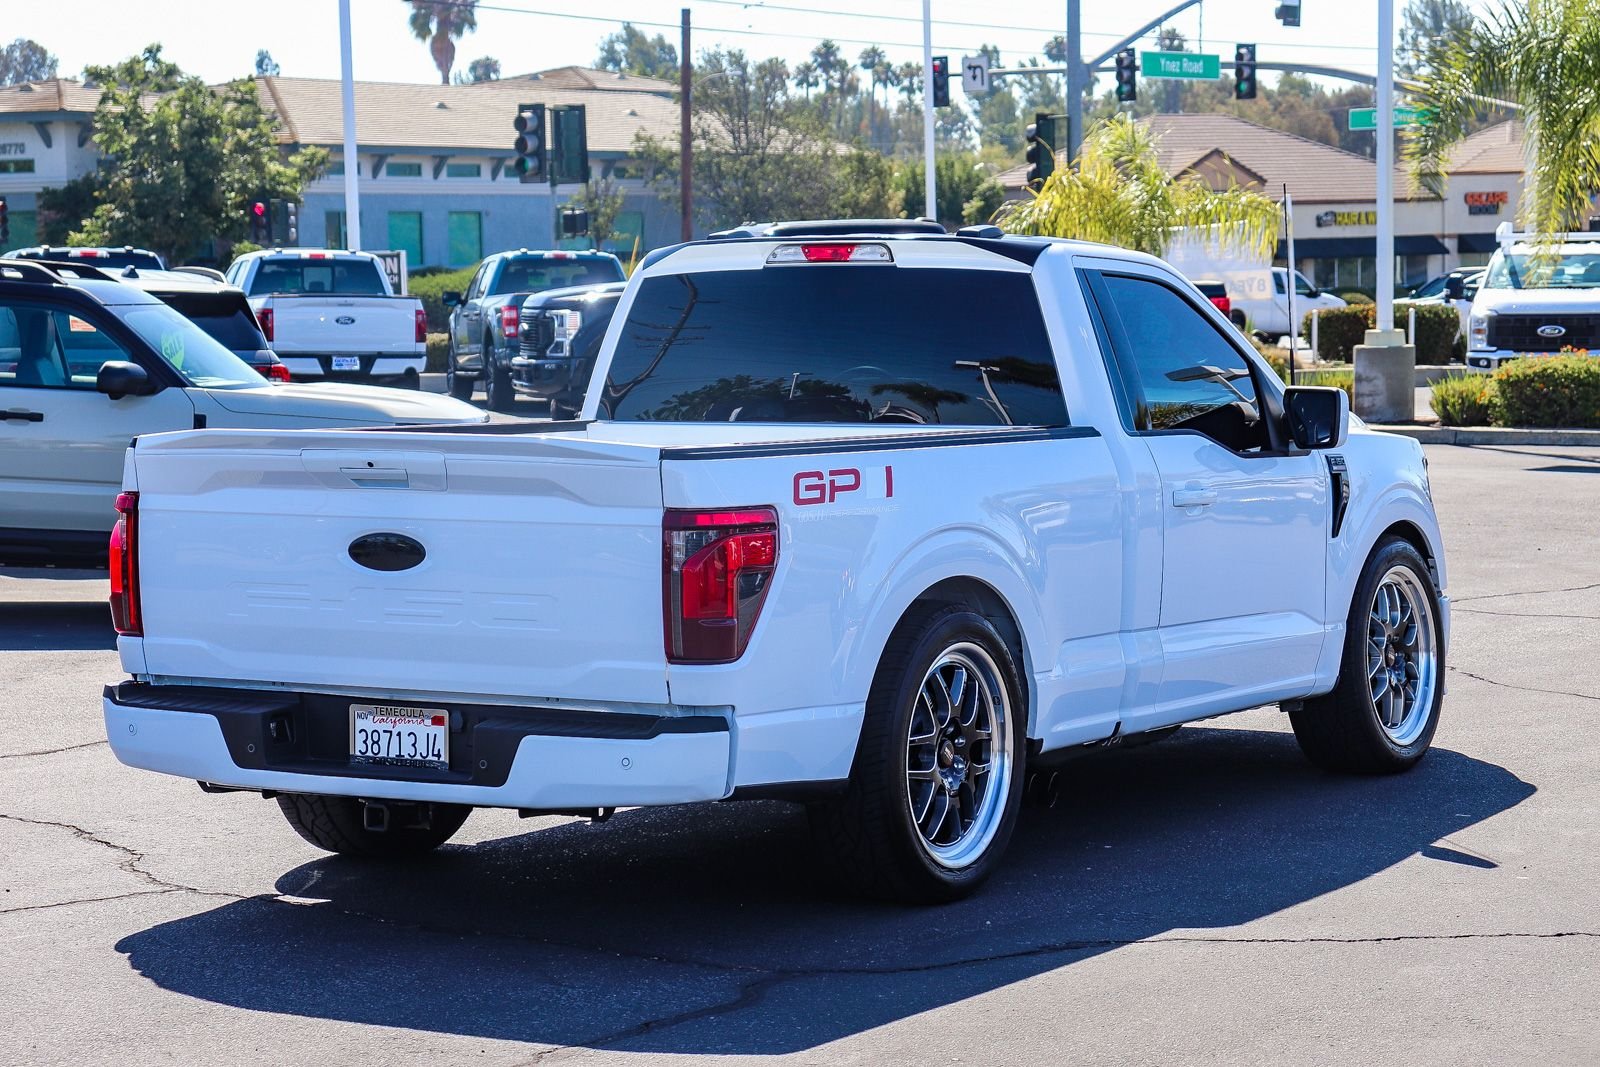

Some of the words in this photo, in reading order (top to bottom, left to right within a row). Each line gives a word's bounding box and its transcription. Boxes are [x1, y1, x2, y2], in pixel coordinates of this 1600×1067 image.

[1160, 58, 1180, 72] Ynez
[1182, 58, 1203, 73] Road
[356, 711, 369, 720] NOV
[373, 706, 425, 718] TEMECULA
[372, 715, 431, 728] California
[358, 728, 441, 760] 38713J4
